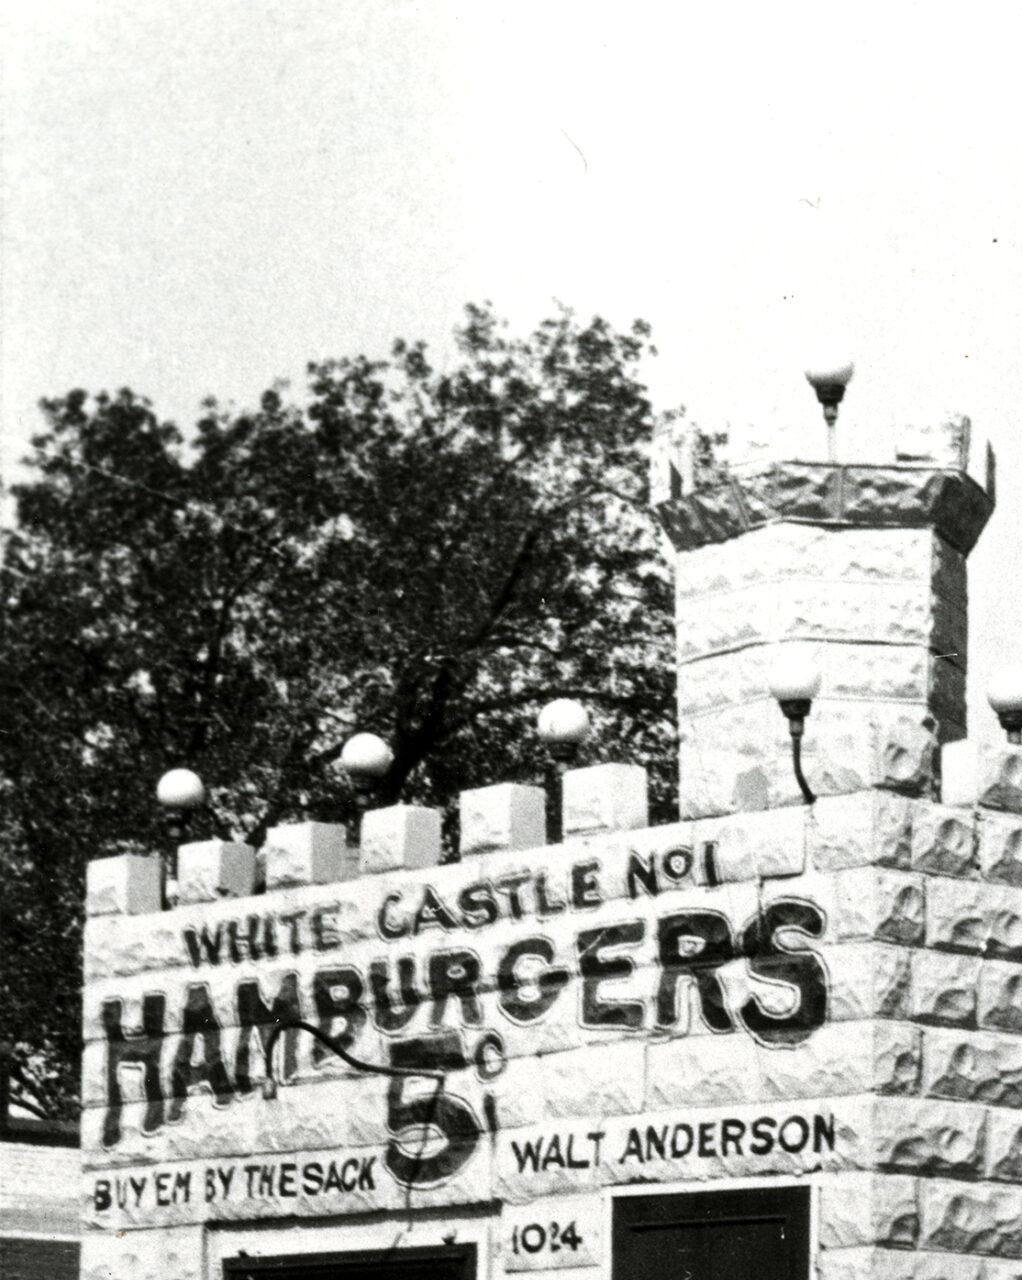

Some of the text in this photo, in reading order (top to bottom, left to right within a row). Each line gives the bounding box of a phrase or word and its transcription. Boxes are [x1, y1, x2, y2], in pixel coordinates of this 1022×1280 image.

[183, 902, 342, 968] WHITE
[376, 858, 602, 942] CASTLE
[99, 896, 829, 1151] HAMBURGERS
[94, 1176, 147, 1211] BUY
[204, 1165, 235, 1203] BY
[244, 1163, 298, 1199] THE
[302, 1156, 377, 1196] SACK
[510, 1113, 835, 1173] WALT ANDERSON
